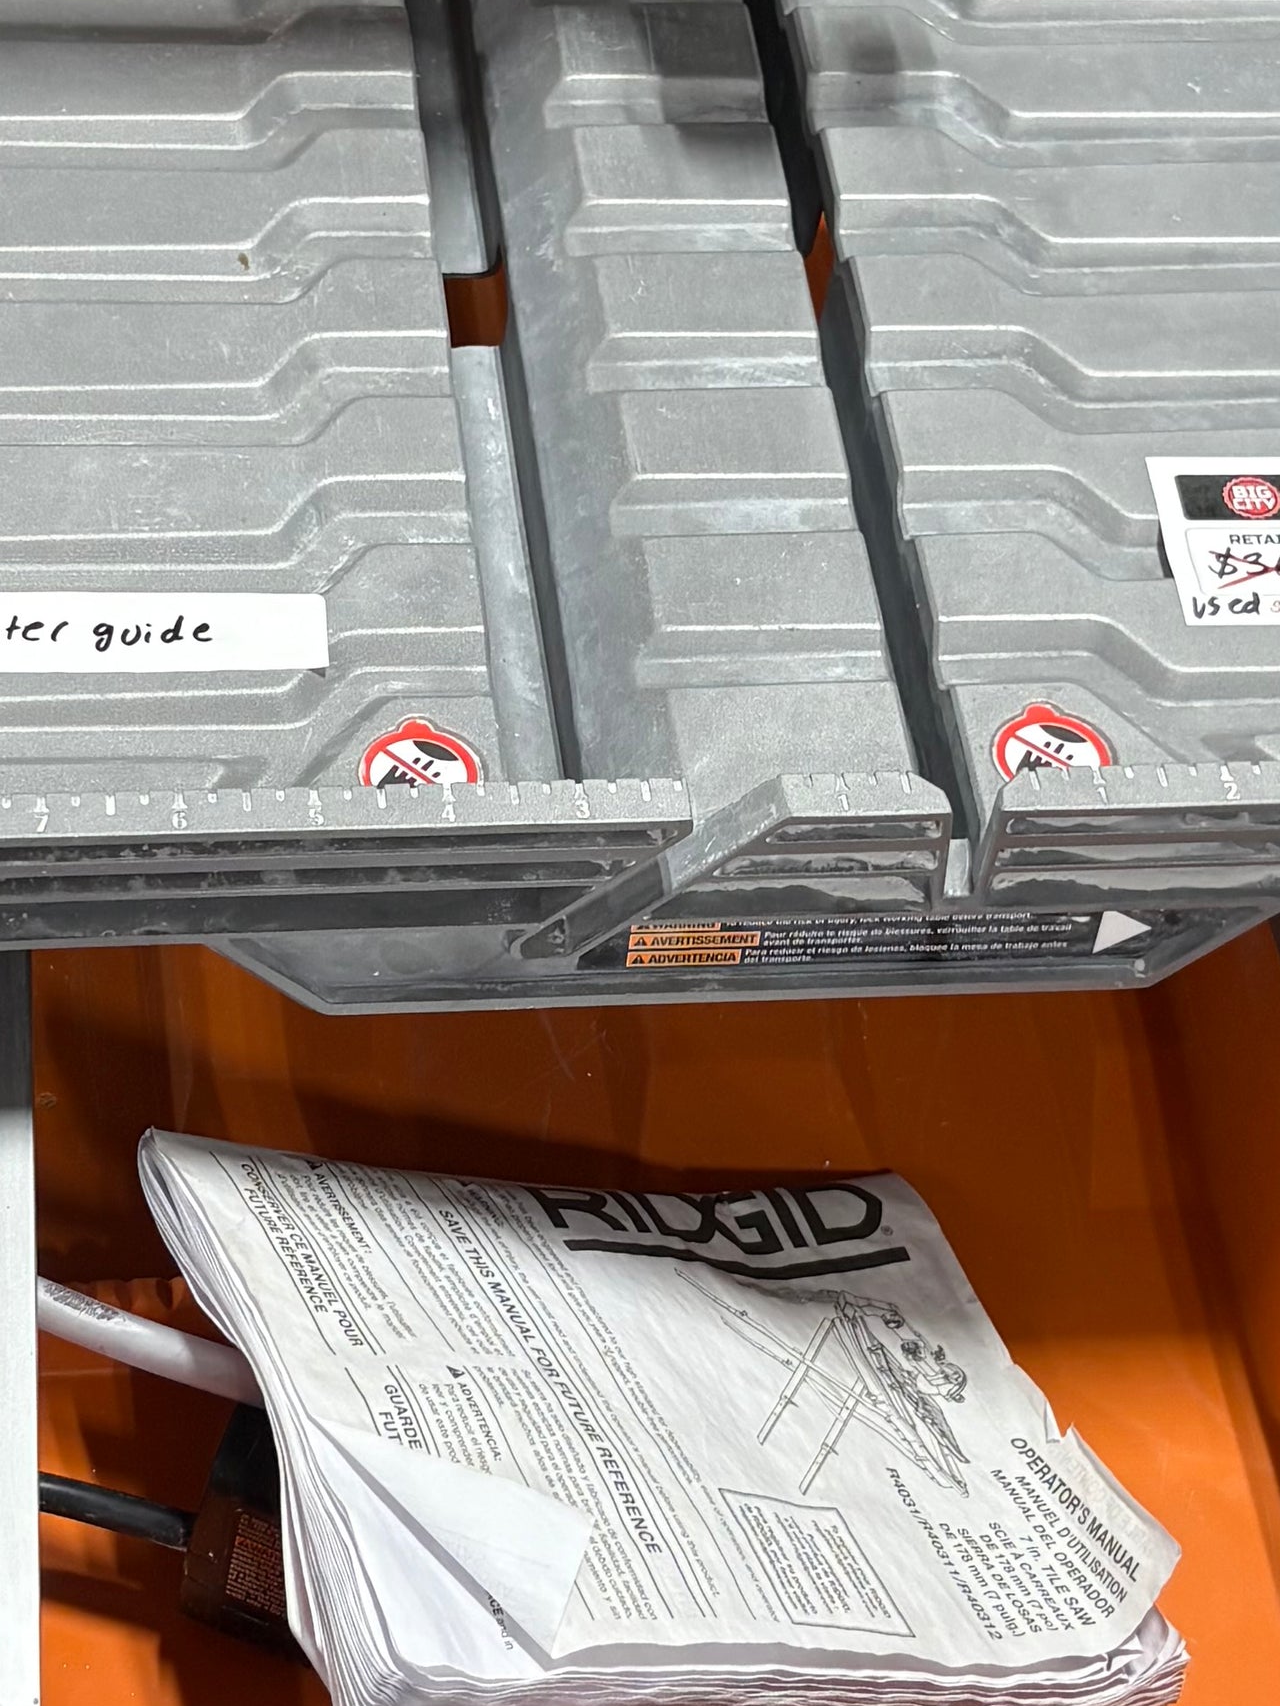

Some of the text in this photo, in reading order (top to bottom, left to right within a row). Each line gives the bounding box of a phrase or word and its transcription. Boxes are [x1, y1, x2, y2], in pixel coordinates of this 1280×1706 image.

[1232, 485, 1270, 499] BIG
[1232, 498, 1276, 511] CITY
[93, 615, 212, 651] guide
[33, 815, 50, 833] 7
[171, 810, 188, 830] 6
[307, 808, 325, 826] 5
[440, 804, 457, 822] 4
[574, 800, 591, 820] 3
[837, 792, 850, 811] 1
[1096, 784, 1109, 805] 1
[1223, 780, 1241, 800] 2
[647, 948, 737, 966] ADVERTENCIA
[745, 947, 768, 957] Para
[770, 945, 806, 955] reducir
[808, 945, 816, 953] el
[817, 944, 848, 955] riesgo
[850, 944, 863, 953] de
[949, 942, 959, 950] la
[961, 941, 987, 951] mesa
[990, 941, 1002, 950] de
[1040, 939, 1067, 949] antes
[650, 931, 756, 949] AVERTISSEMENT
[763, 930, 786, 940] Pour
[871, 928, 882, 936] de
[885, 925, 933, 937] blessures,
[988, 923, 997, 932] la
[1000, 923, 1024, 932] table
[1026, 923, 1038, 932] de
[1041, 922, 1071, 932] travail
[744, 954, 814, 965] del transporte.
[764, 934, 863, 947] avant de transporter.
[242, 1183, 330, 1317] FUTURE RÉFÉRENCE
[531, 1181, 882, 1255] RIDGID
[239, 1159, 364, 1351] CONSERVER CE MANUEL POUR
[383, 1381, 423, 1453] GUARDE
[417, 1381, 450, 1439] de usar este
[430, 1381, 446, 1401] leer
[437, 1204, 472, 1249] SAVE
[464, 1244, 495, 1282] THIS
[487, 1277, 537, 1344] MANUAL
[530, 1342, 561, 1382] FOR
[552, 1376, 602, 1445] FUTURE
[593, 1441, 663, 1558] REFERENCE
[442, 1380, 482, 1448] Para reducir el
[457, 1378, 503, 1463] ADVERTENCIA:
[989, 1465, 1037, 1522] MANUAL
[1031, 1520, 1058, 1551] DEL
[1052, 1548, 1116, 1618] OPERADOR
[1008, 1432, 1094, 1526] OPERATOR'S
[1081, 1517, 1146, 1584] MANUAL
[1013, 1471, 1062, 1529] MANUEL
[1054, 1524, 1129, 1603] D'UTILISATION
[936, 1519, 1023, 1640] DE 178 mm (7 pulg.)
[954, 1524, 1043, 1635] SIERRA DE LOSAS
[977, 1530, 1059, 1634] DE 178 mm (7 po)
[985, 1518, 1077, 1633] SCIE À CARREAUX
[1017, 1531, 1095, 1630] 7 in. TILE SAW
